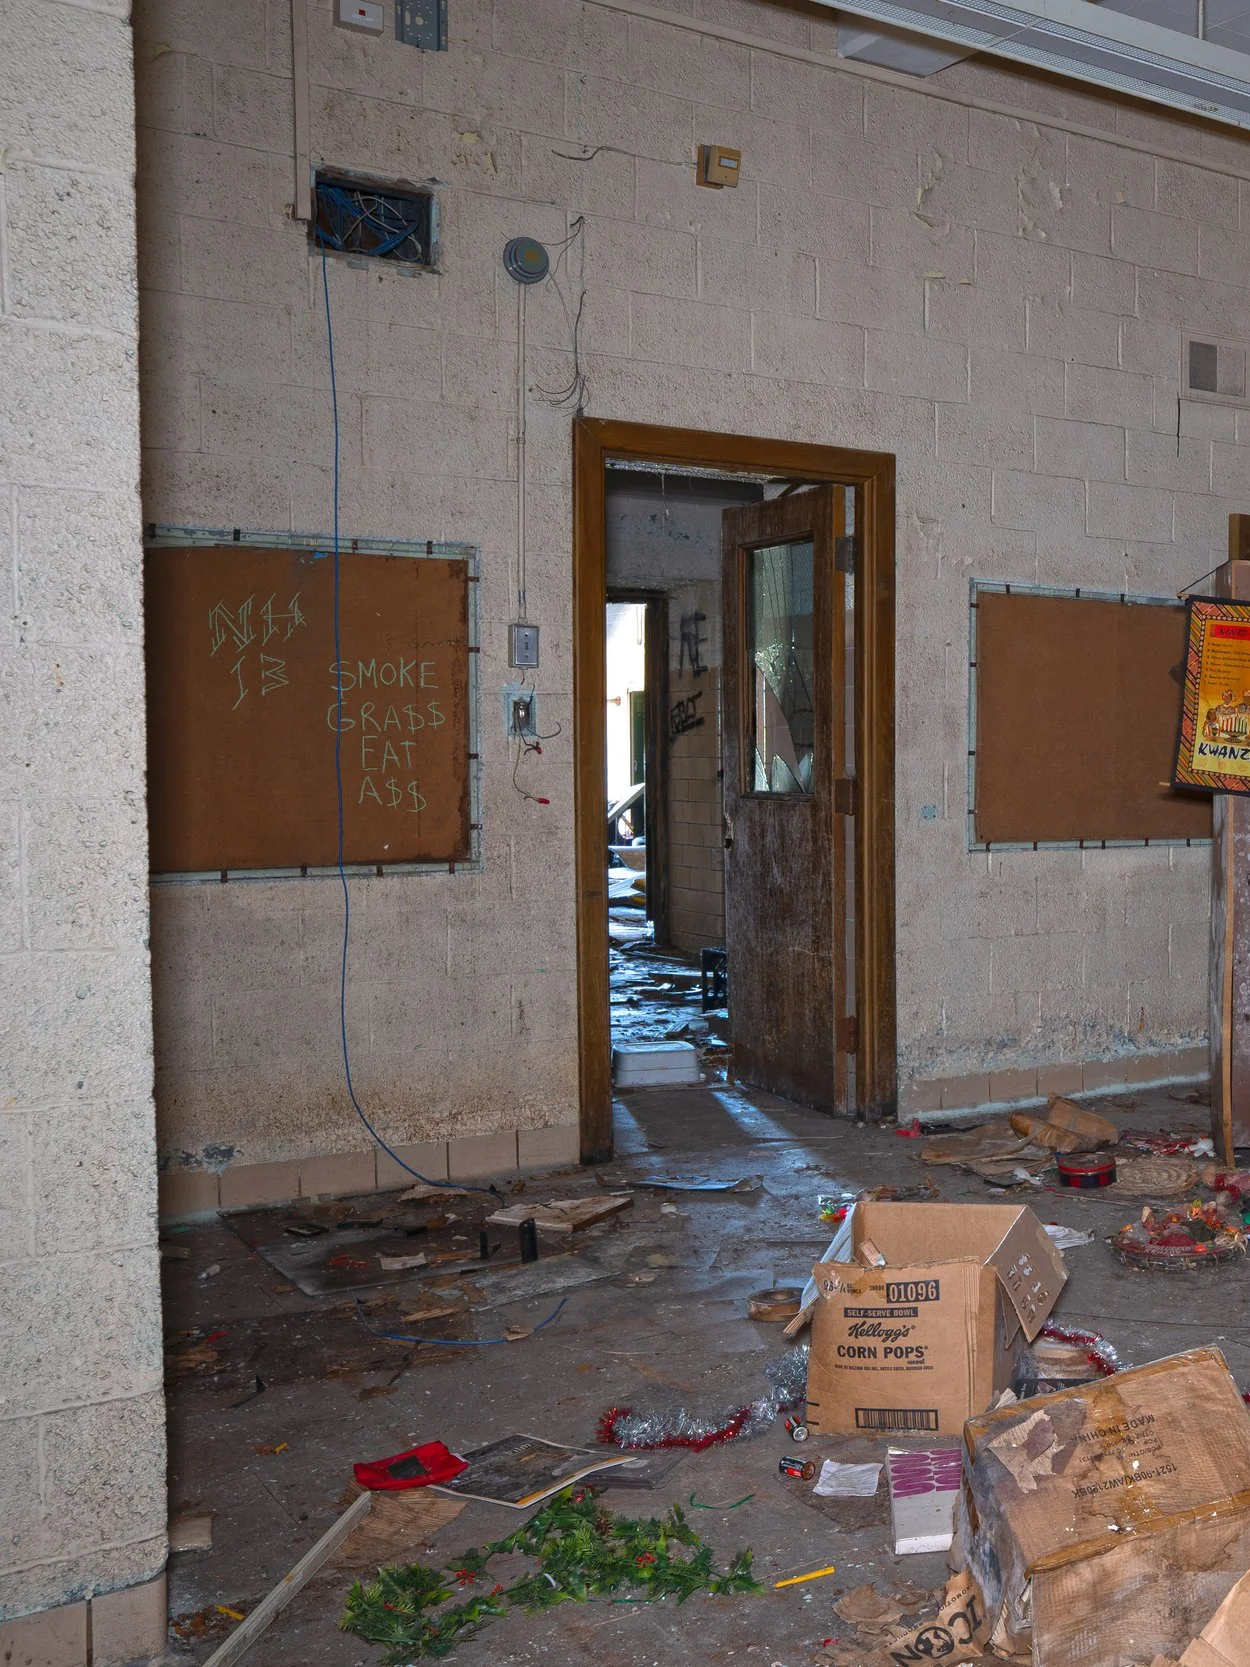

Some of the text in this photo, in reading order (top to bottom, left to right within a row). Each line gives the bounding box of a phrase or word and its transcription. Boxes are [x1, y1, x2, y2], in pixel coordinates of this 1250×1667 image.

[361, 735, 418, 774] EAT
[358, 776, 427, 813] A$$
[889, 1282, 937, 1302] 01096
[847, 1309, 891, 1317] SELF-SERVE
[848, 1320, 911, 1343] Kellogg's
[836, 1345, 925, 1359] CORN POPS
[1108, 1426, 1121, 1436] IN
[1123, 1414, 1155, 1431] MADE
[1071, 1428, 1107, 1444] CHINA
